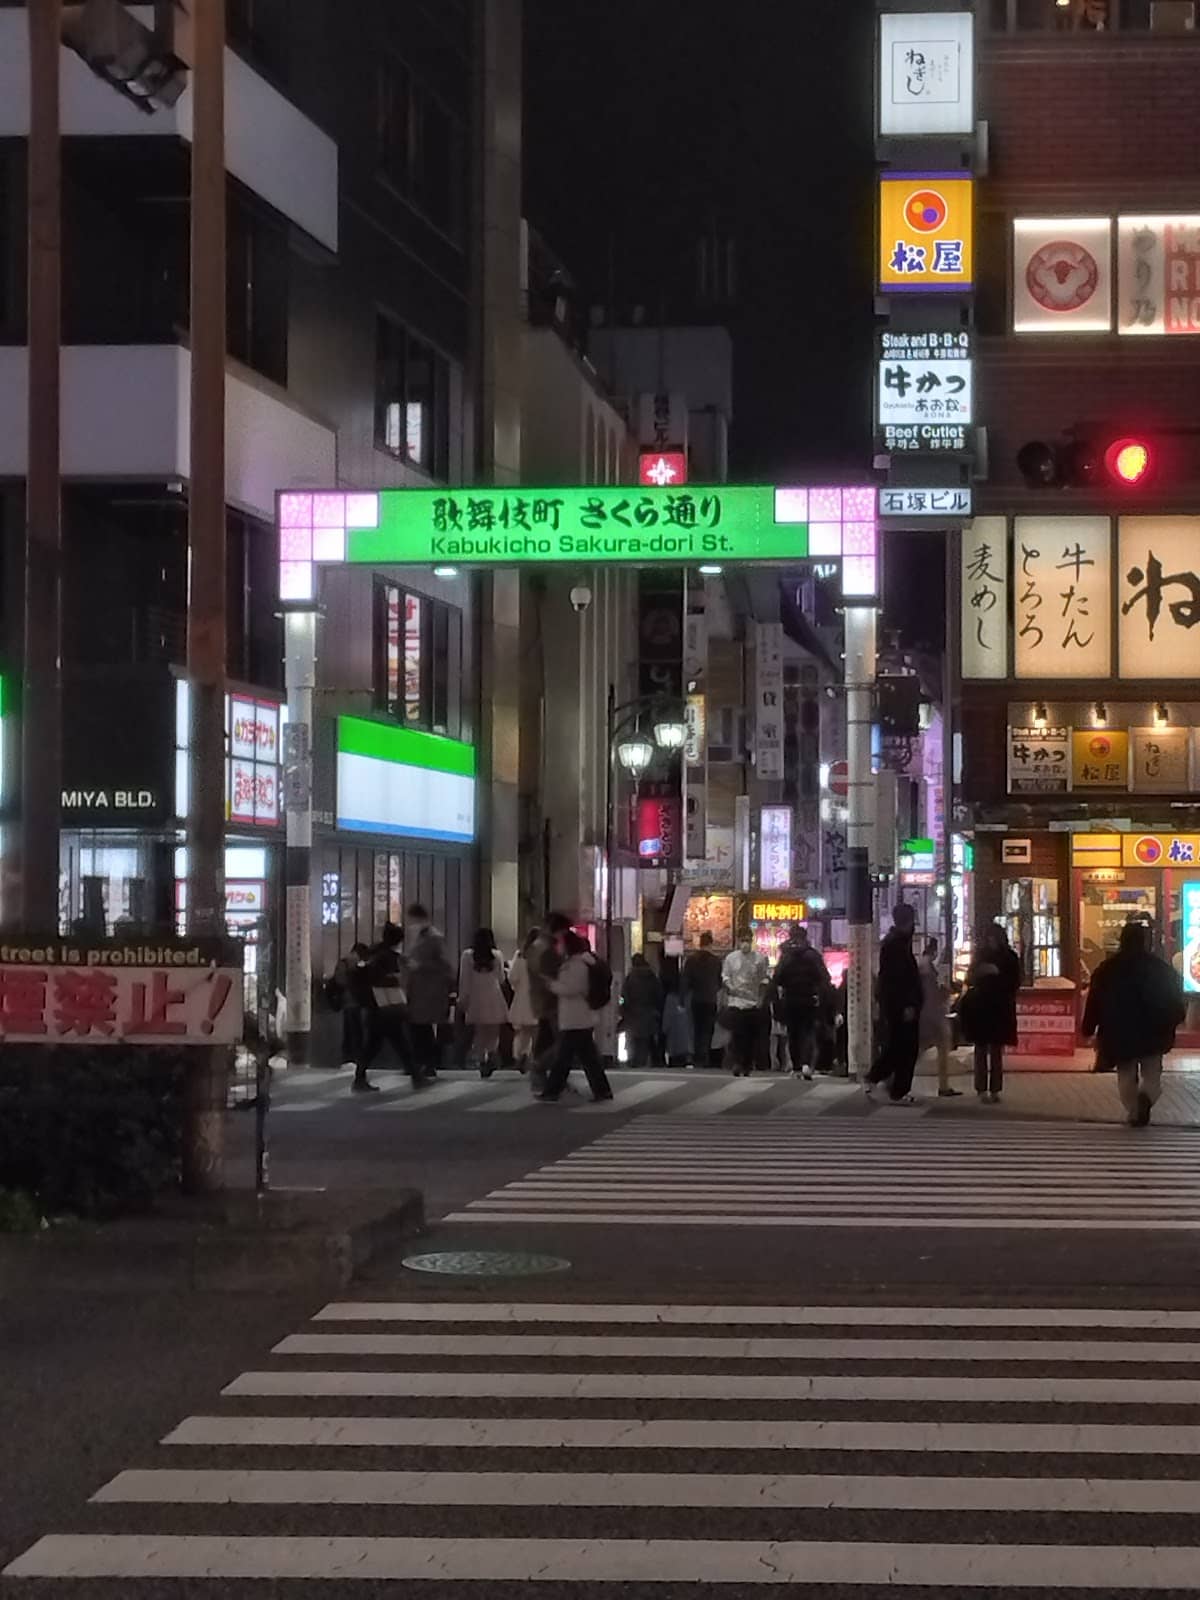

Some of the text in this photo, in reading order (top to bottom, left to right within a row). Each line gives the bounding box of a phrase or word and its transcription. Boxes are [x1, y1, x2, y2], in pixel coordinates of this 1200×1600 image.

[890, 242, 963, 273] 松屋
[882, 333, 909, 347] Steak
[884, 364, 967, 397] 牛かつ
[885, 426, 965, 439] Beef Cutlet
[884, 490, 969, 512] 石塚ビル
[431, 494, 722, 532] 歌舞伎町 さくら通り
[431, 534, 735, 554] Kabukicho Sakura-dori St.
[966, 543, 1004, 650] 麦めし
[1019, 543, 1044, 649] とろろ
[1055, 543, 1095, 648] 牛たん
[1121, 549, 1200, 642] ね
[1013, 743, 1066, 765] 牛かつ
[1081, 763, 1121, 780] 松屋
[61, 791, 157, 808] MIYA BLD.
[1168, 840, 1200, 863] 松
[62, 946, 80, 962] is
[87, 946, 206, 966] prohibited.
